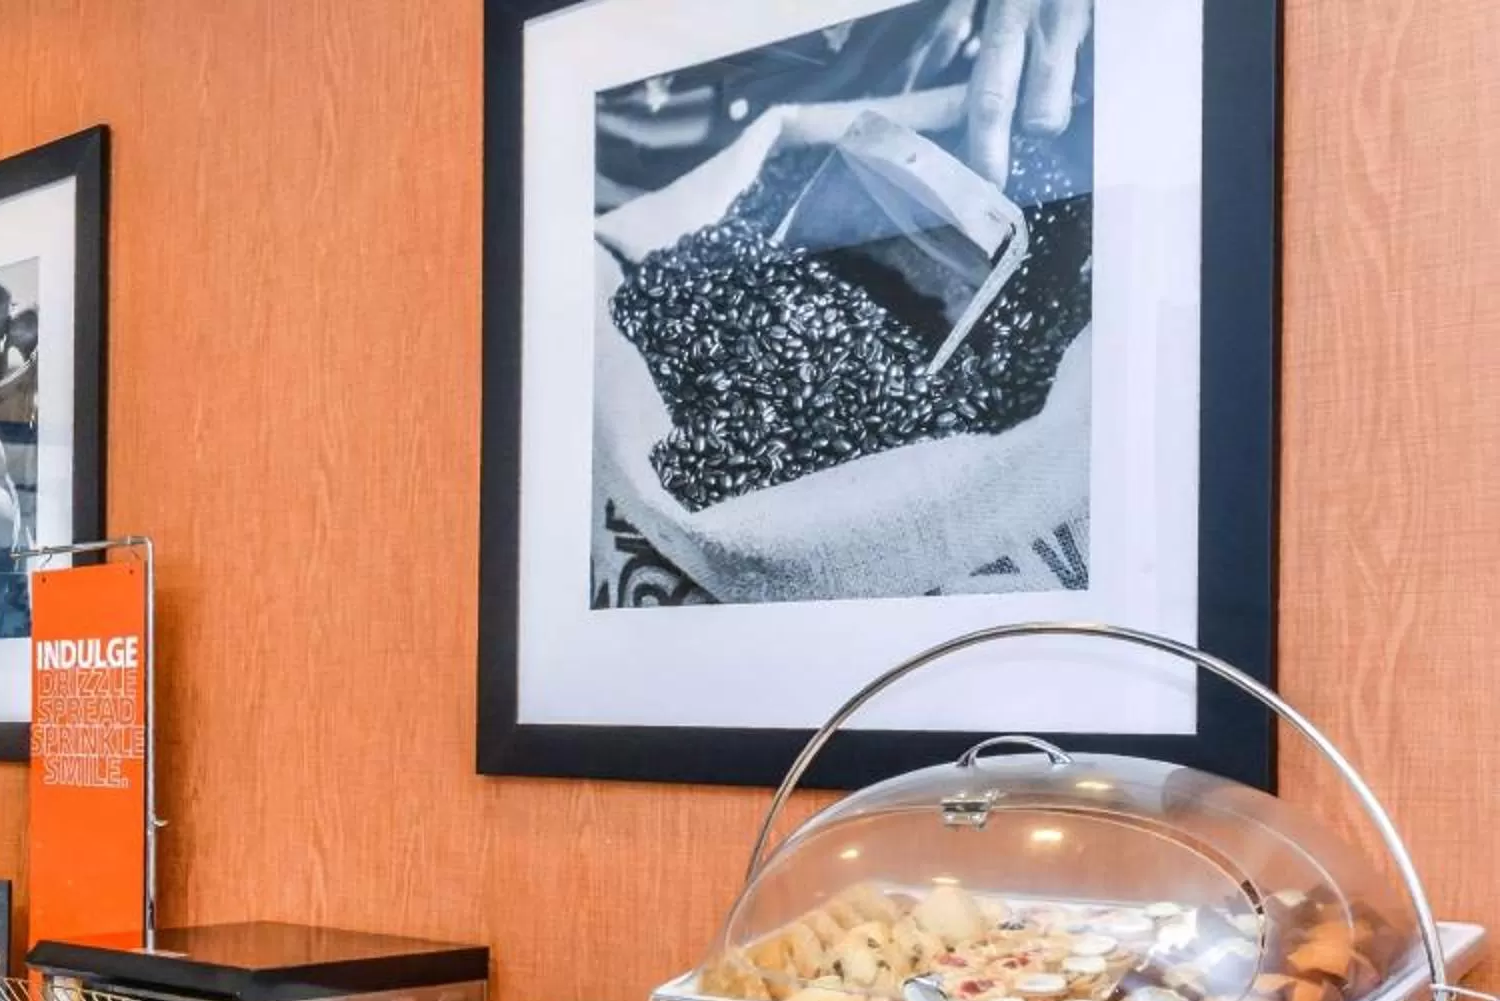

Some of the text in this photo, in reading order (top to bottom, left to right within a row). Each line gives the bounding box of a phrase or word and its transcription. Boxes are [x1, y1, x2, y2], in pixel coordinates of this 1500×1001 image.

[36, 636, 138, 669] INDULGE
[38, 668, 137, 698] DRIZZLE
[37, 697, 135, 725] SPREAD
[31, 724, 145, 758] SPRINKLE
